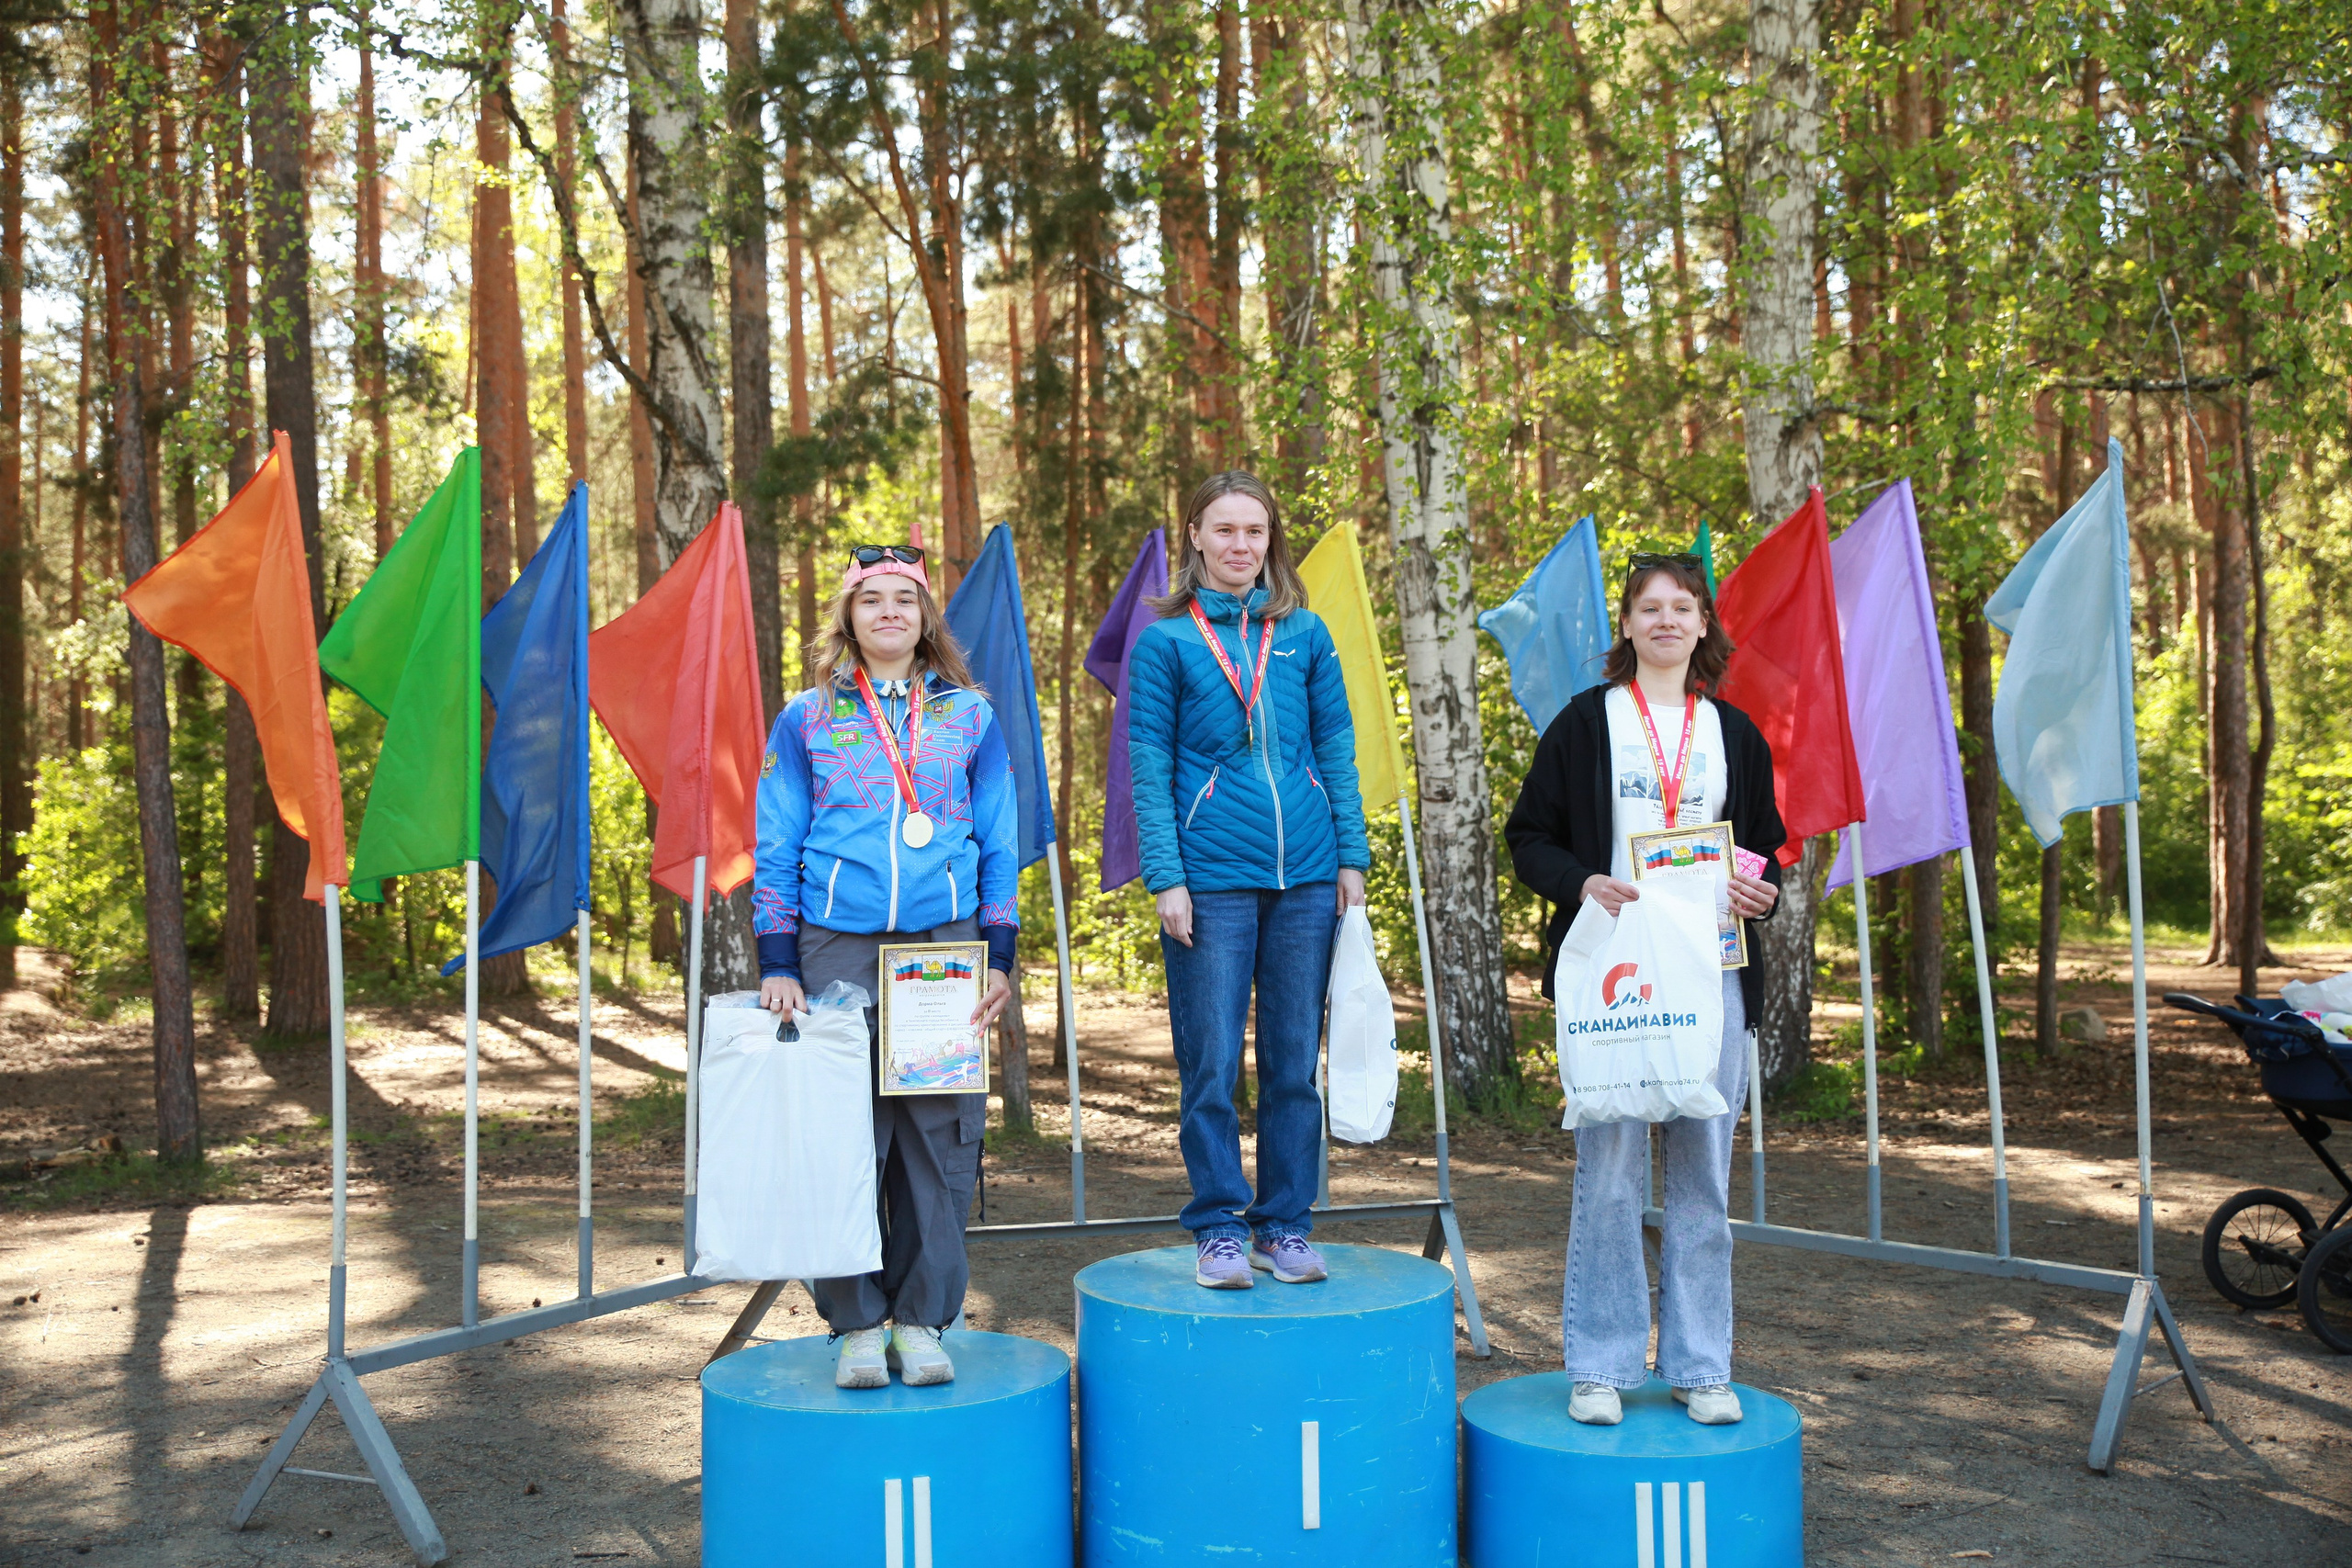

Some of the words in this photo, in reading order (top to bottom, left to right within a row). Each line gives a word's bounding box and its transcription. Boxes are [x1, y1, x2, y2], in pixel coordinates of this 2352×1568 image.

[837, 733, 855, 742] SFR
[1567, 1012, 1697, 1034] СКАНДИНАВИЯ
[1591, 1034, 1640, 1047] спортивный
